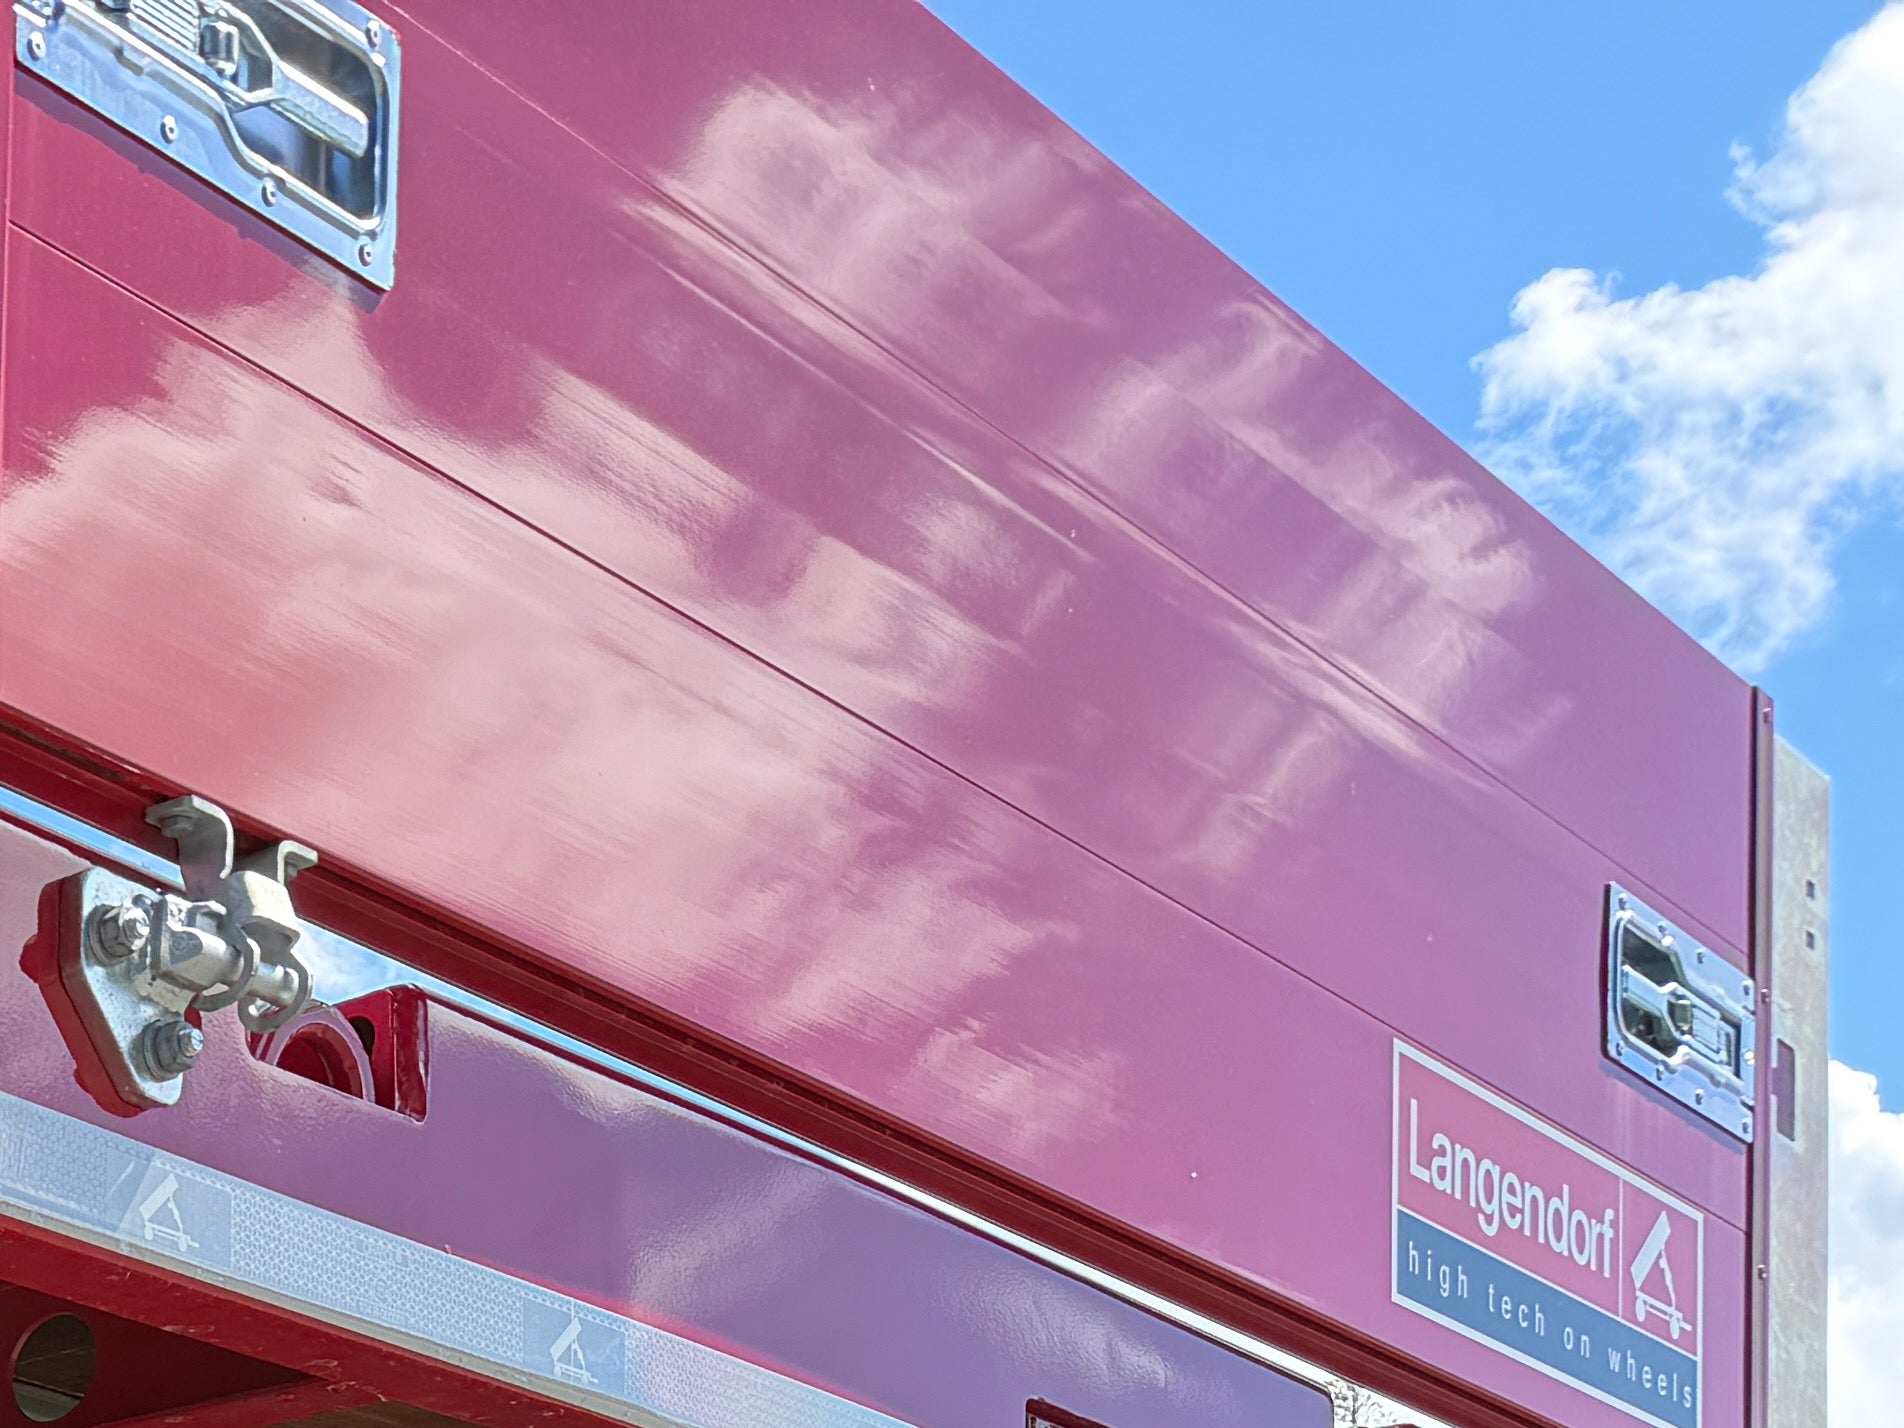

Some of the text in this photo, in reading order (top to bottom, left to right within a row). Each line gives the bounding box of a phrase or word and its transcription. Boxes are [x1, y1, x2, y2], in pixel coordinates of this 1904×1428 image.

[1409, 1098, 1614, 1278] Langendorf
[1408, 1241, 1692, 1408] high tech on wheels
